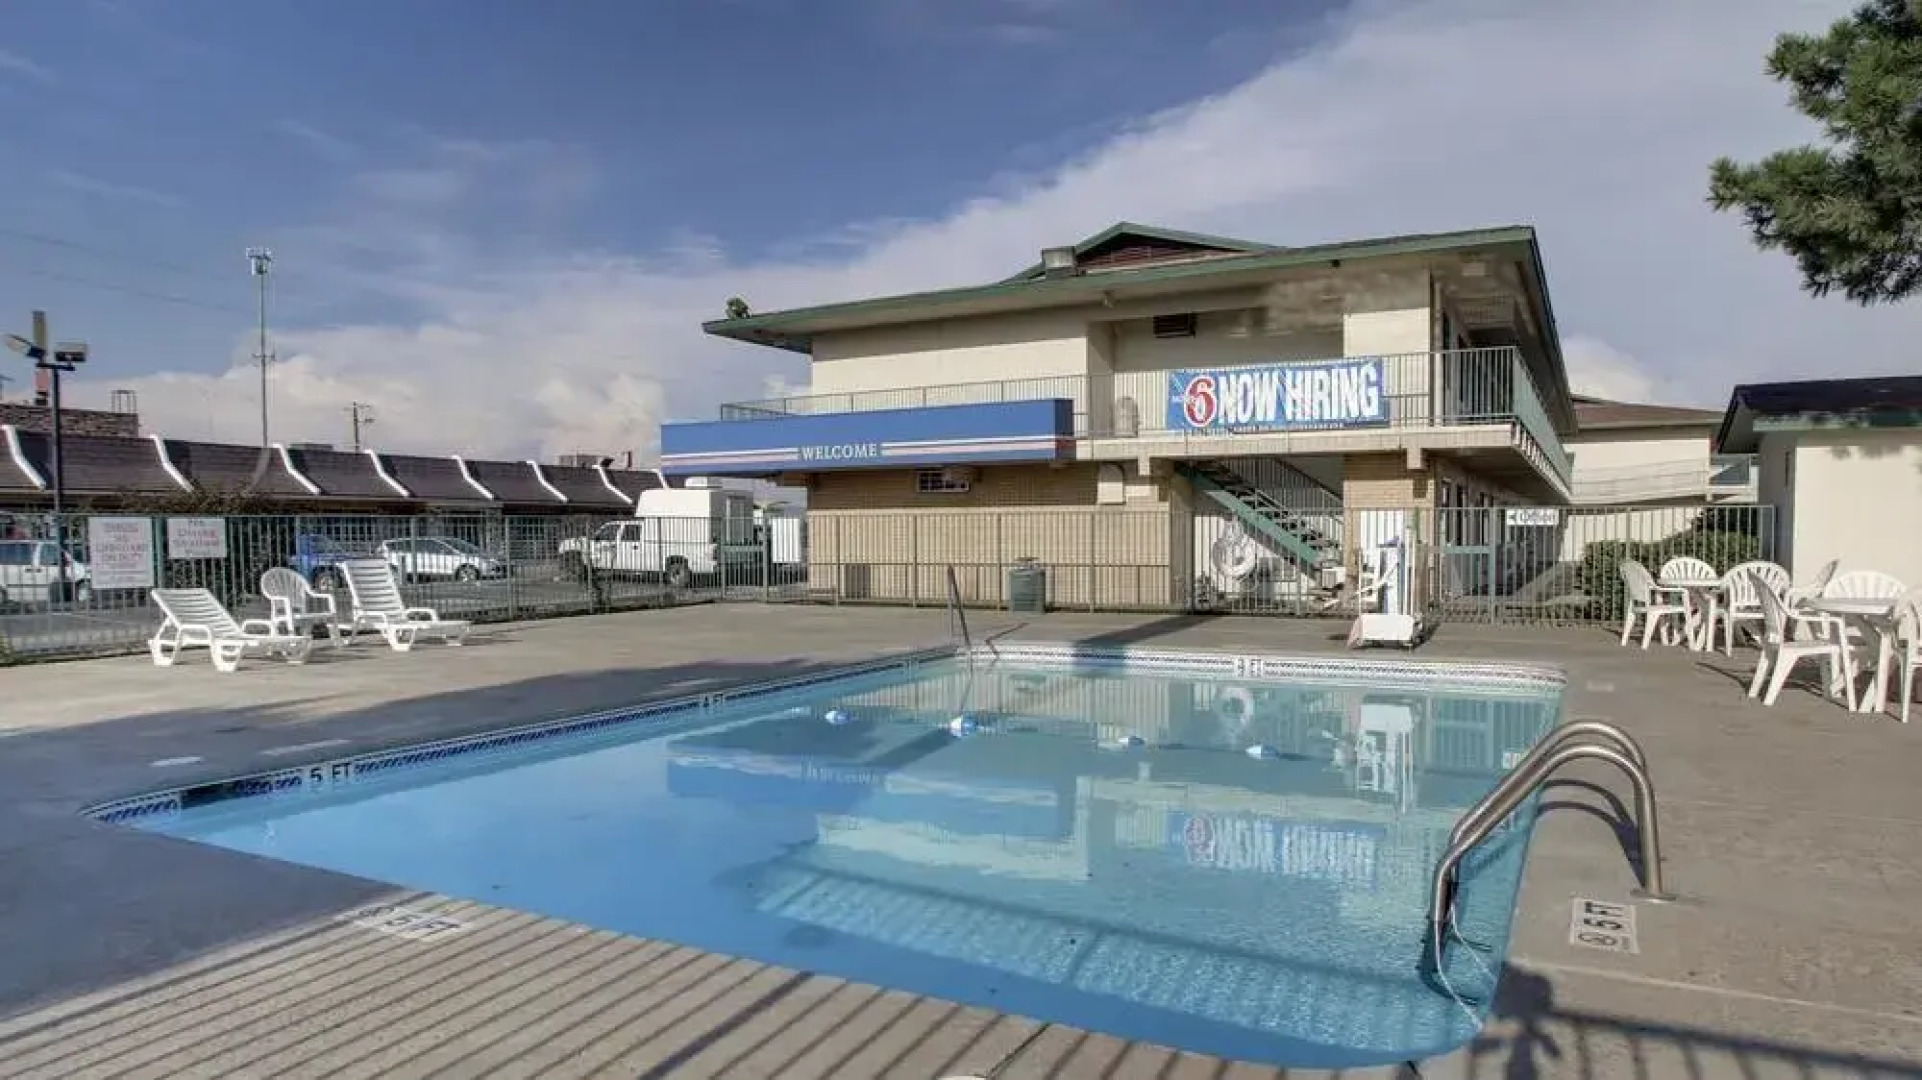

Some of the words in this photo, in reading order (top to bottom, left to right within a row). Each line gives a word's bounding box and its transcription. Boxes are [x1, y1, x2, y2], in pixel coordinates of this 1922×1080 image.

[1219, 371, 1280, 424] NOW
[1285, 365, 1379, 421] HIRING
[801, 443, 878, 460] WELCOME
[310, 766, 323, 782] 5
[332, 762, 351, 779] FT
[1583, 918, 1623, 930] 5
